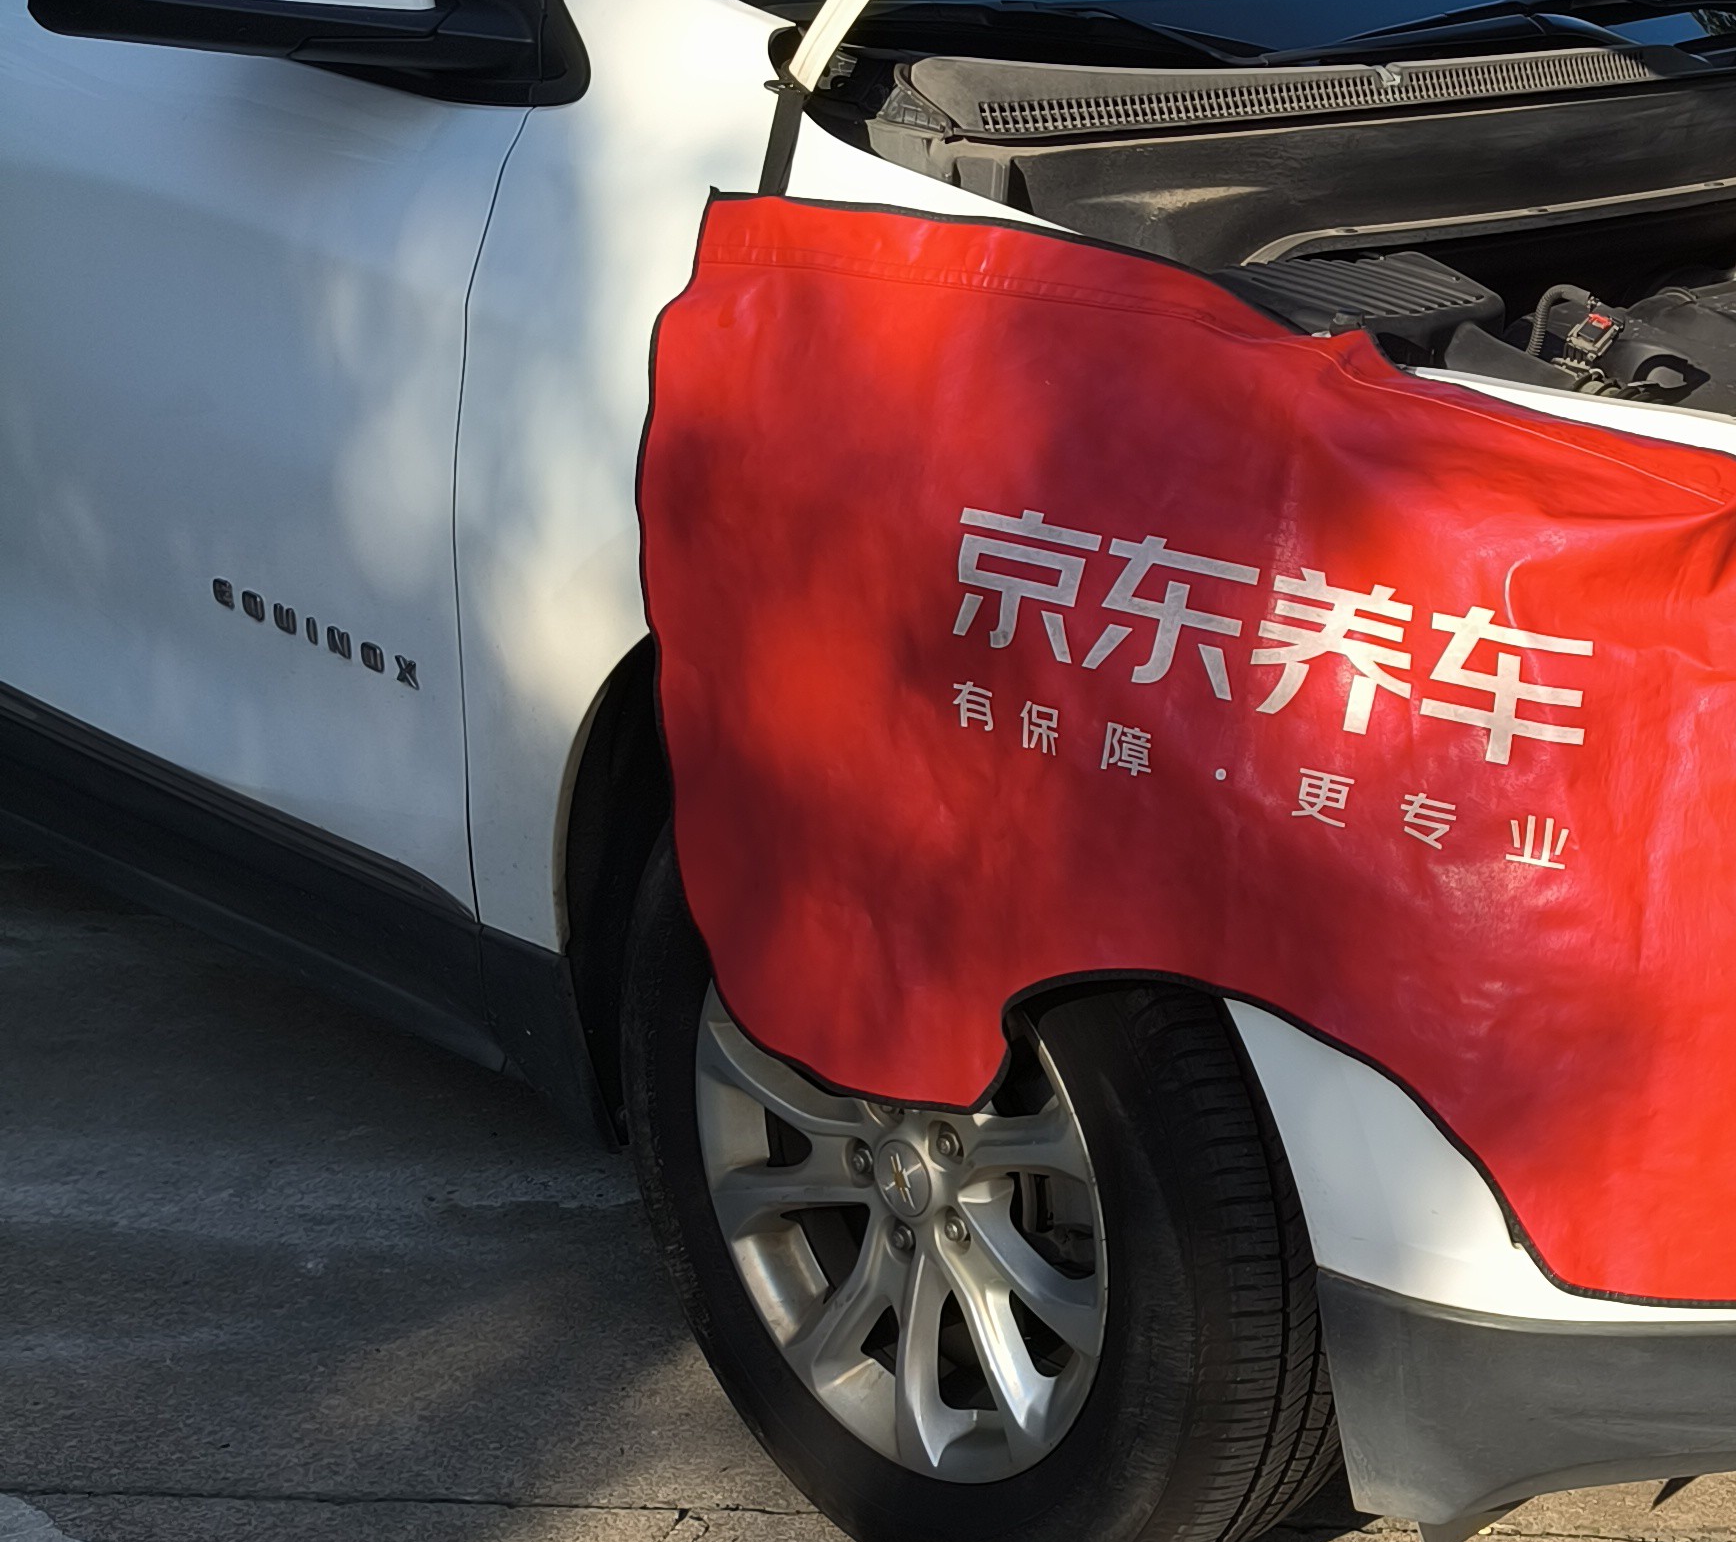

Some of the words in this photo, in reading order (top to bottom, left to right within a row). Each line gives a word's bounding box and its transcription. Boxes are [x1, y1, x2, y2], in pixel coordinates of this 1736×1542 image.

[211, 577, 420, 691] EQUINOX
[953, 507, 1593, 766] 京东养车
